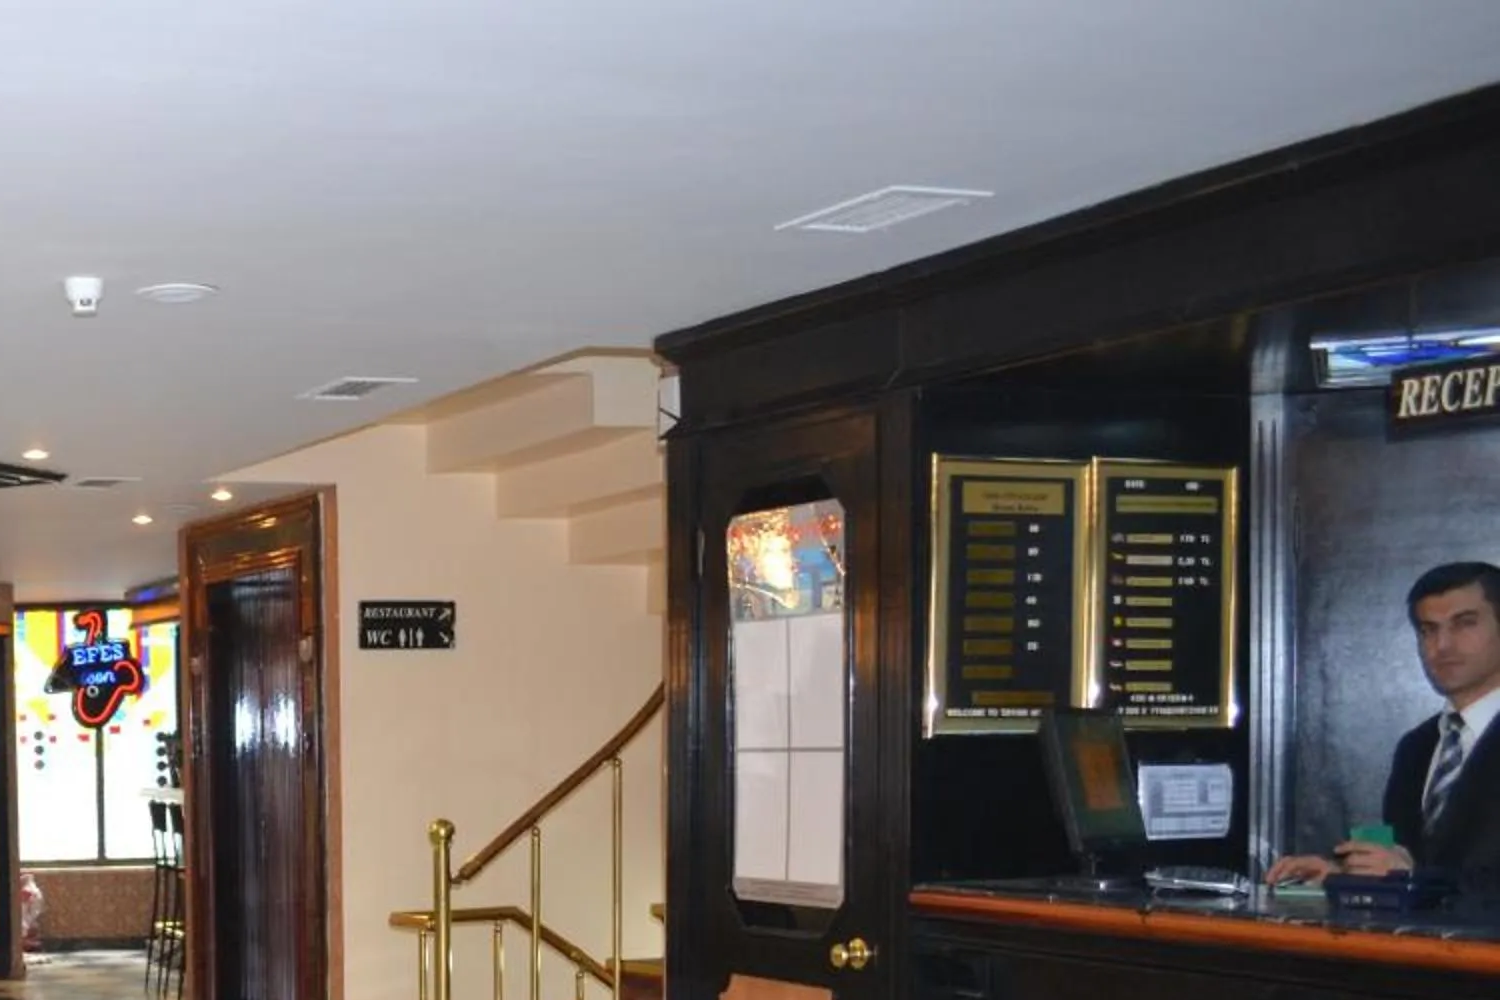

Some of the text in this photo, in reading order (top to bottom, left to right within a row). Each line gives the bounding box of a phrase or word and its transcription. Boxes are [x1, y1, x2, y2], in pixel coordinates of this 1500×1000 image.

[1397, 365, 1500, 418] RECEP
[363, 607, 437, 619] RESTAURANT
[366, 629, 393, 646] WC
[73, 643, 125, 666] EFES
